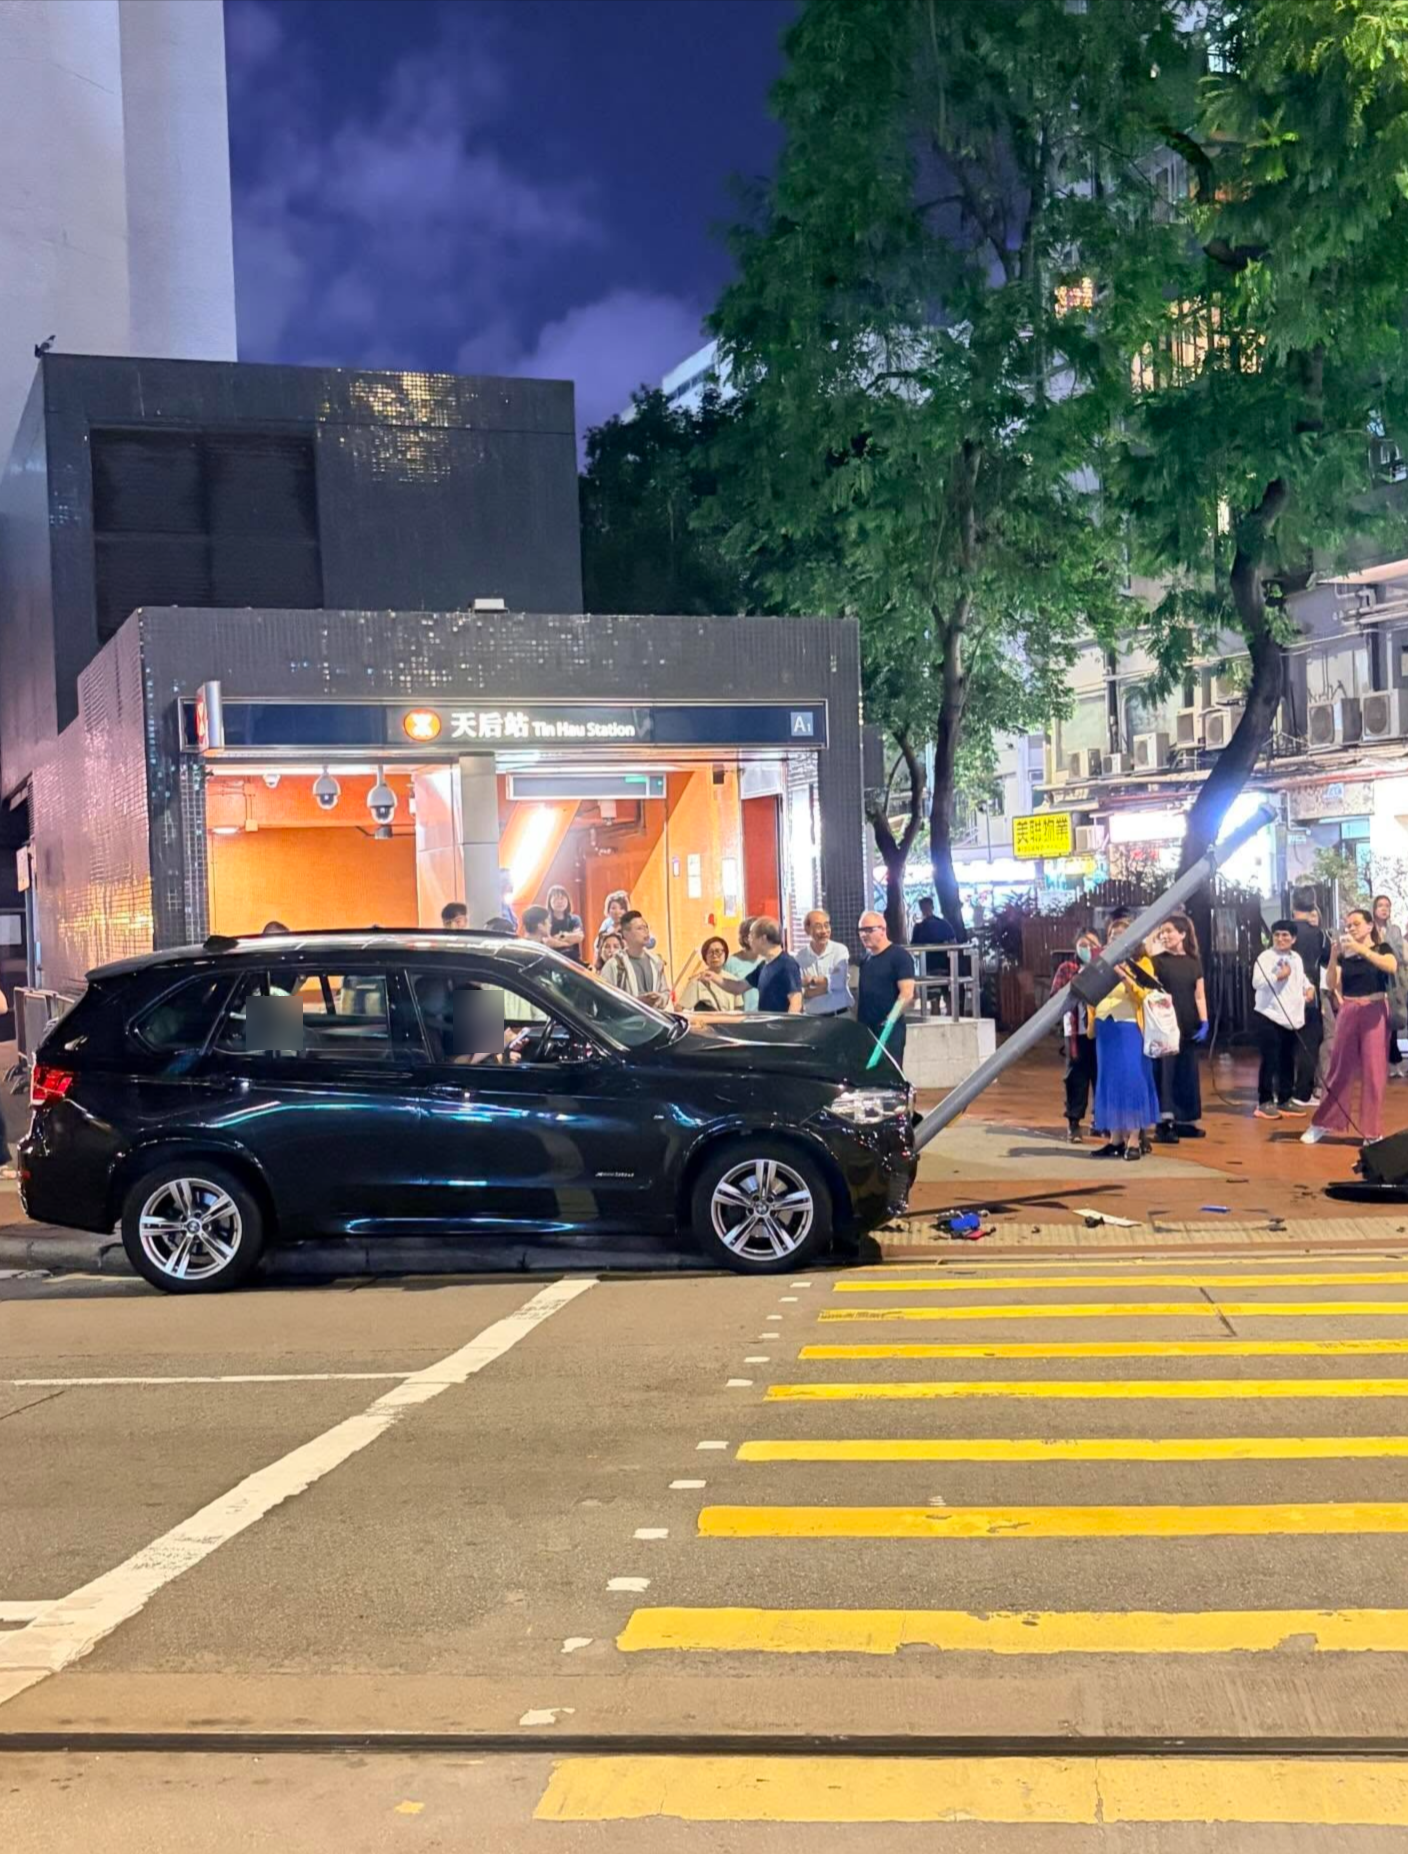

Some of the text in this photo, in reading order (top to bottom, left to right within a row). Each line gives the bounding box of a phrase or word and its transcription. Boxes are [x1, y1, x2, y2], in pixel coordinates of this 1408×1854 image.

[451, 712, 528, 738] 天后站
[532, 721, 635, 737] Tin Hau Station
